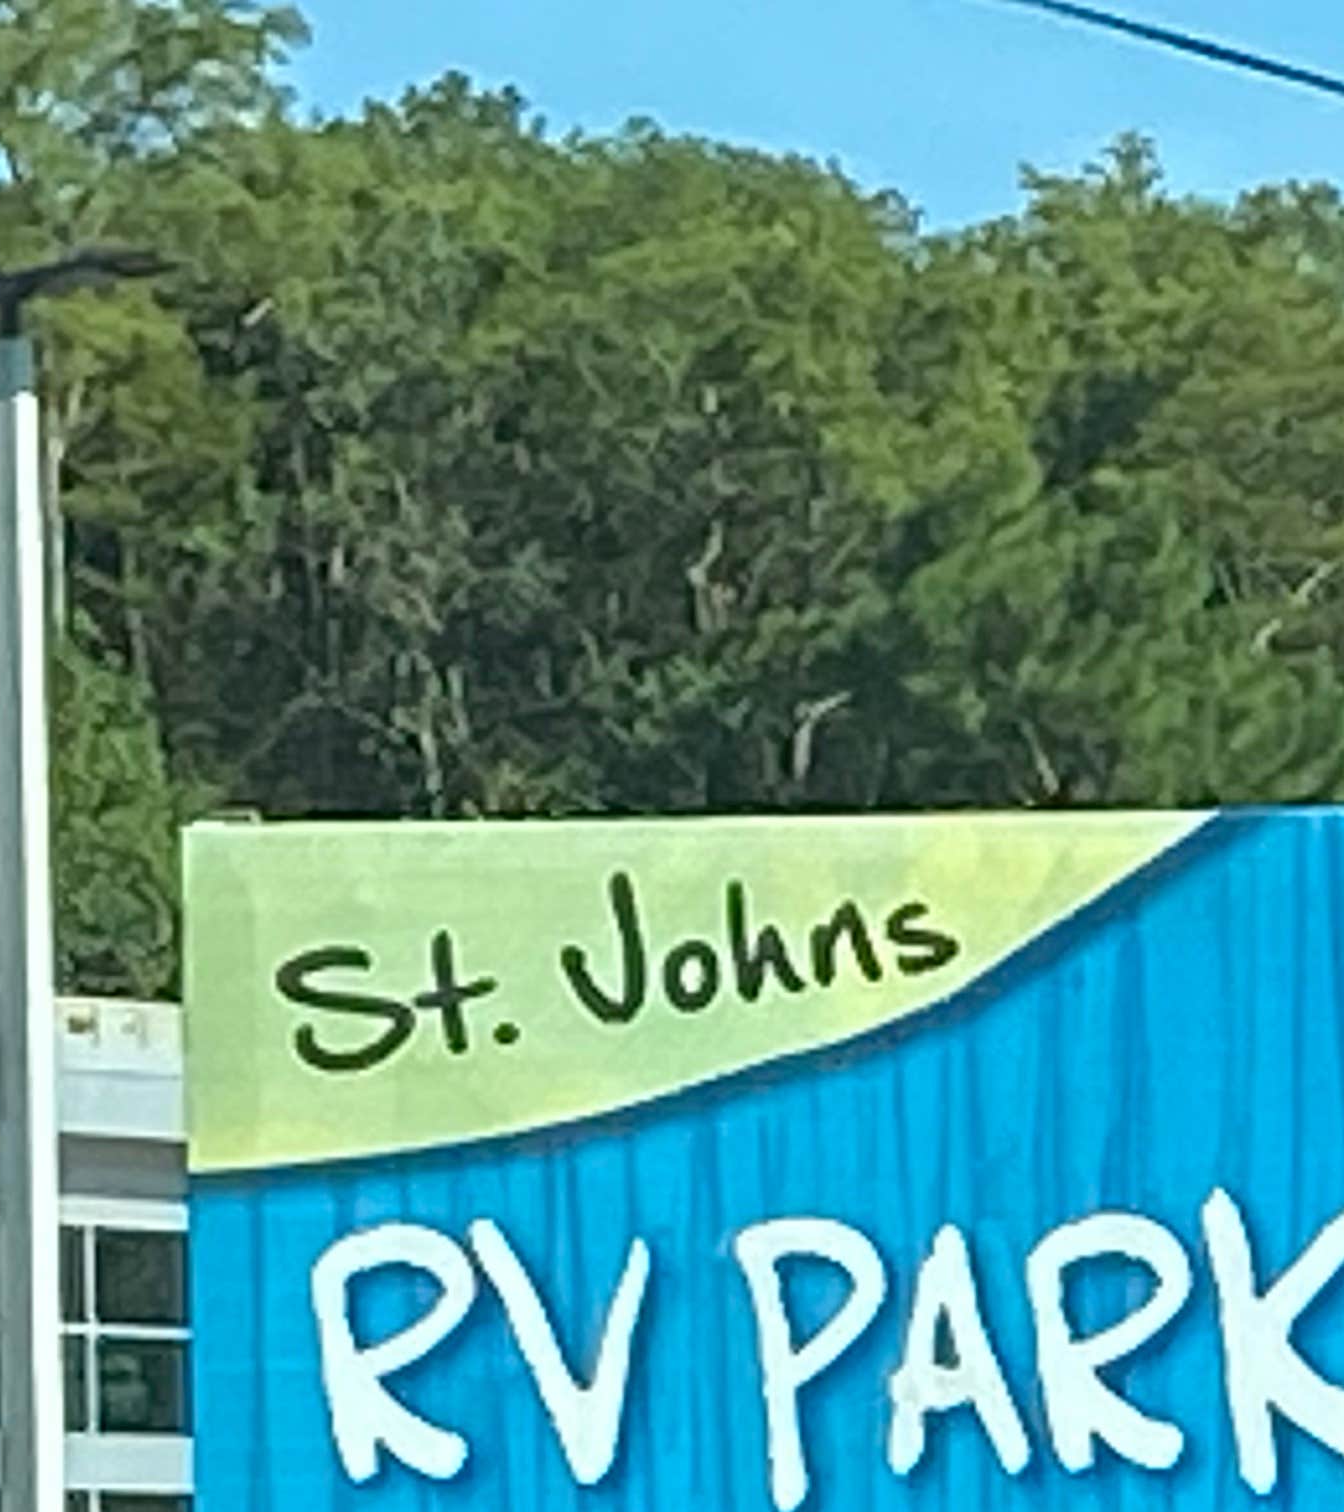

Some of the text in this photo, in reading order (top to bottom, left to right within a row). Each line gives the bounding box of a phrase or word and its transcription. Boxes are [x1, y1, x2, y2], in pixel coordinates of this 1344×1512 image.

[275, 871, 960, 1073] St. Johns
[311, 1219, 649, 1484] RV
